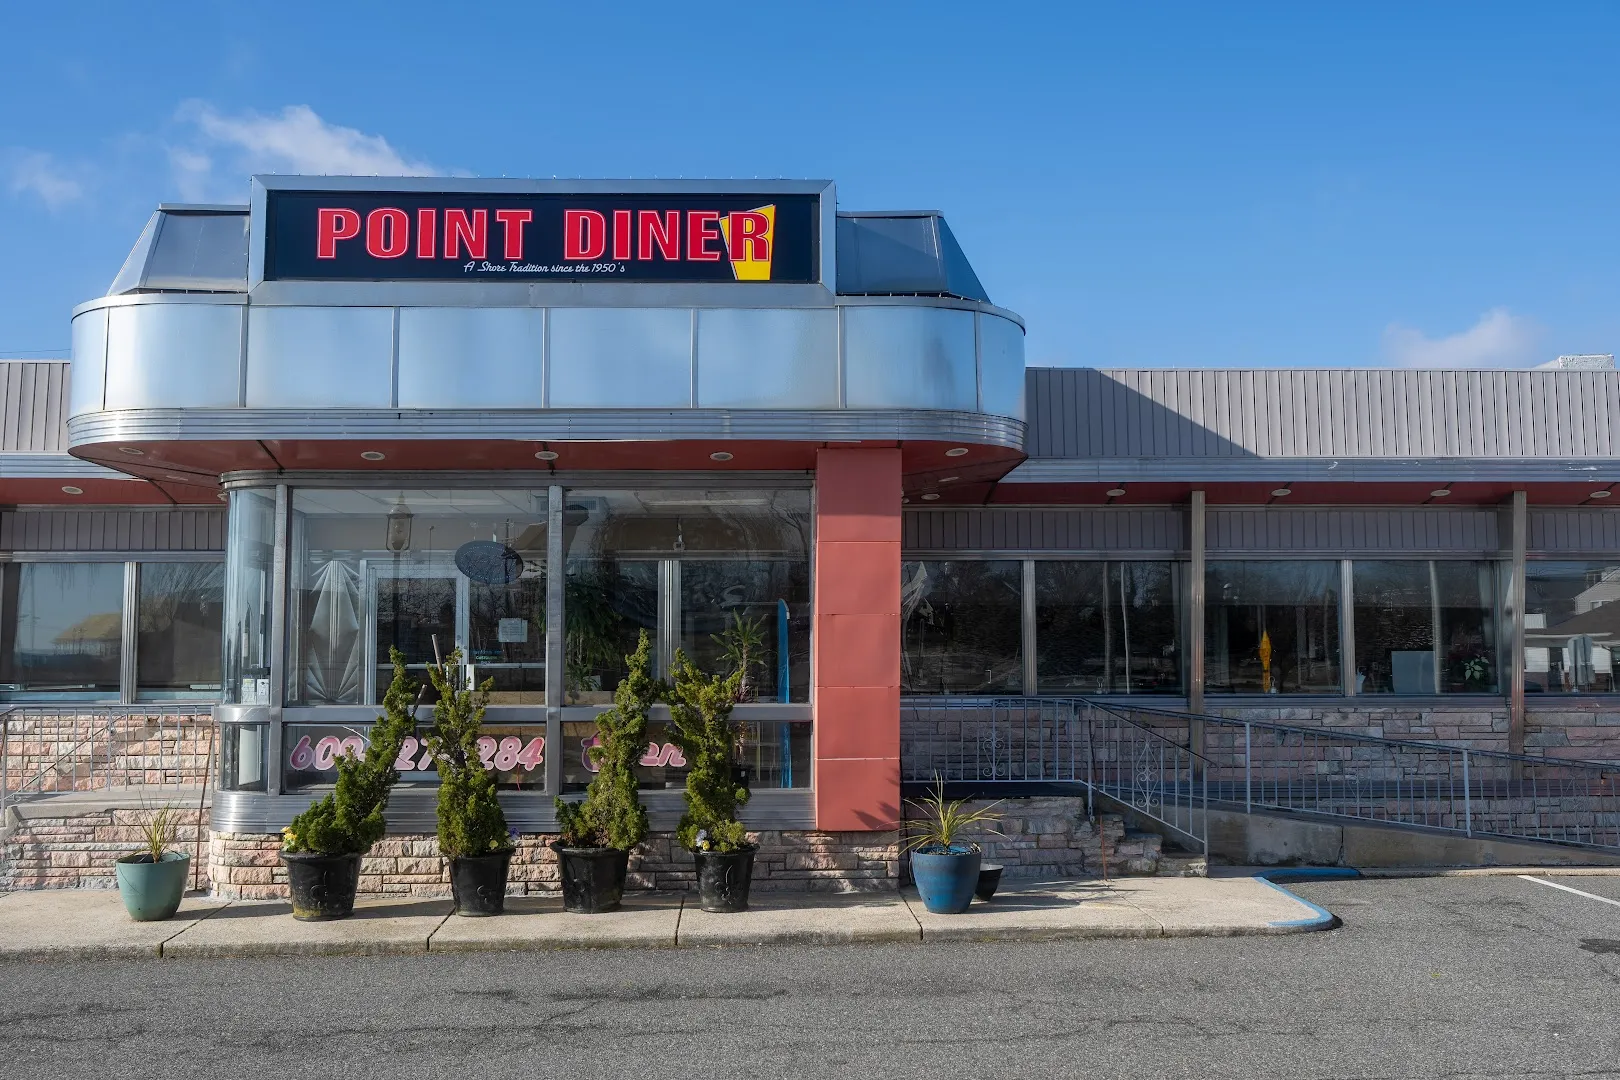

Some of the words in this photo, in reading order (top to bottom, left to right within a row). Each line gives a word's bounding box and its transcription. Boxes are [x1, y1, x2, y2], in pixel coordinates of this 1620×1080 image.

[316, 207, 533, 260] POINT
[563, 209, 770, 262] DINER
[463, 260, 476, 273] A
[477, 260, 507, 272] Shore
[508, 261, 549, 273] Tradition
[550, 264, 574, 273] since
[575, 263, 591, 273] the
[591, 261, 626, 273] 1950's
